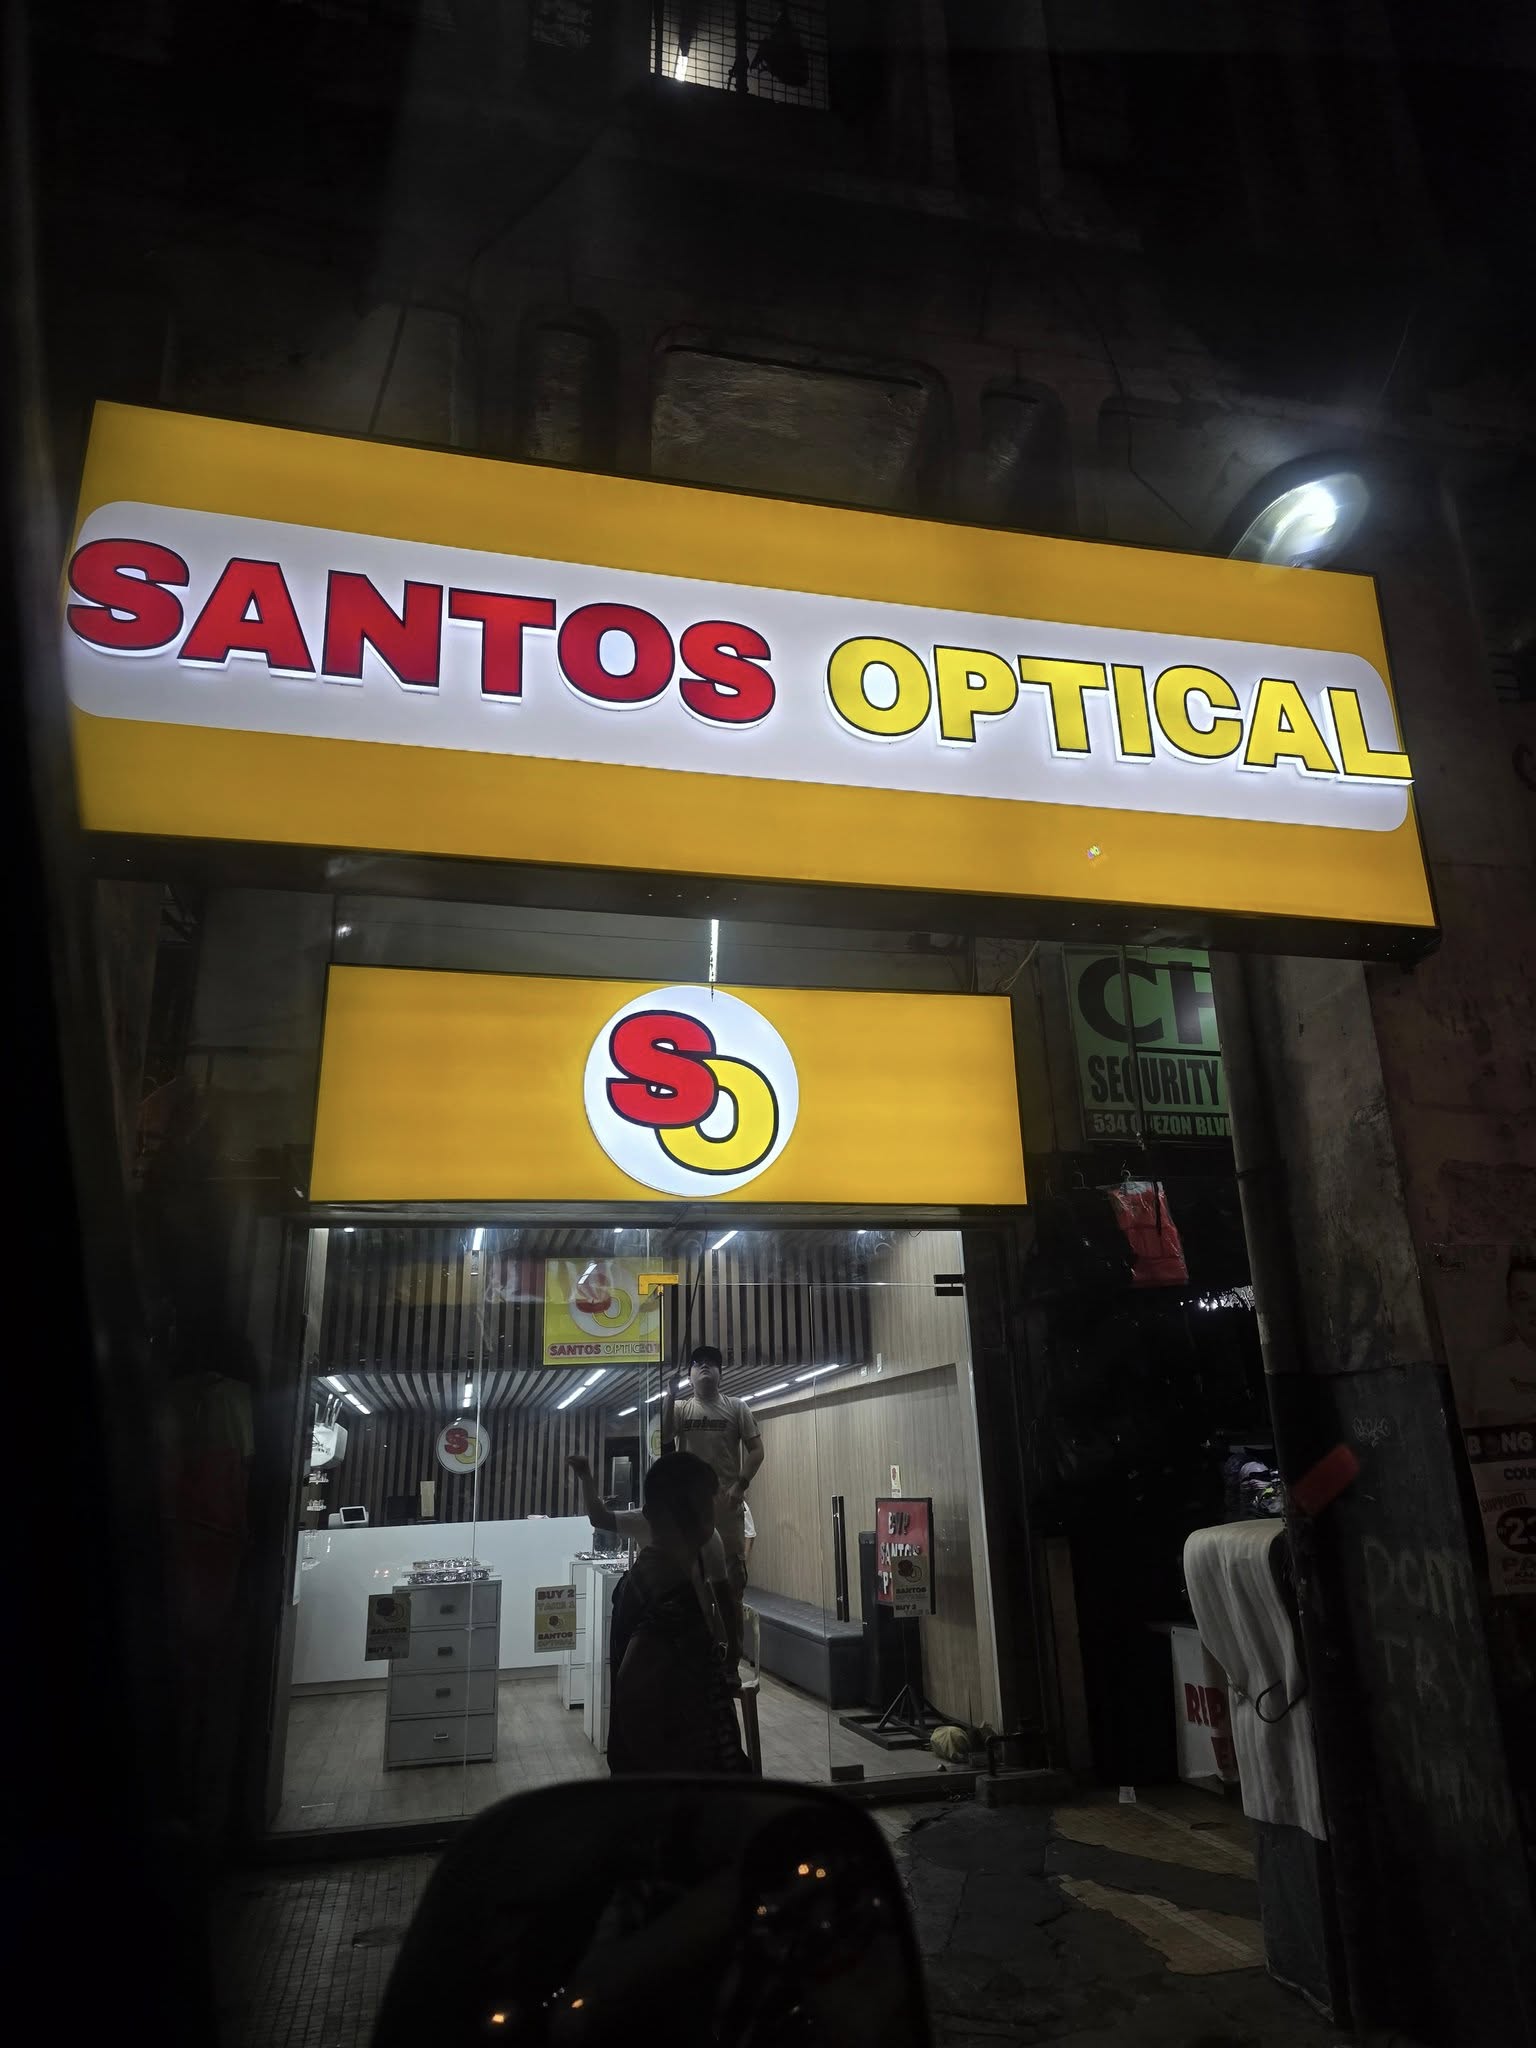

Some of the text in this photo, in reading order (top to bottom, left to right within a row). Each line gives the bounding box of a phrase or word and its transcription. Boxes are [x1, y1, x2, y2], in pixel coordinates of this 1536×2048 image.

[66, 537, 1415, 783] SANTOS OPTICAL
[606, 1009, 780, 1176] SO
[1087, 1054, 1220, 1106] SECURITY
[1093, 1112, 1128, 1134] 534
[549, 1343, 602, 1356] SANTOS
[537, 1588, 575, 1601] BUY 2
